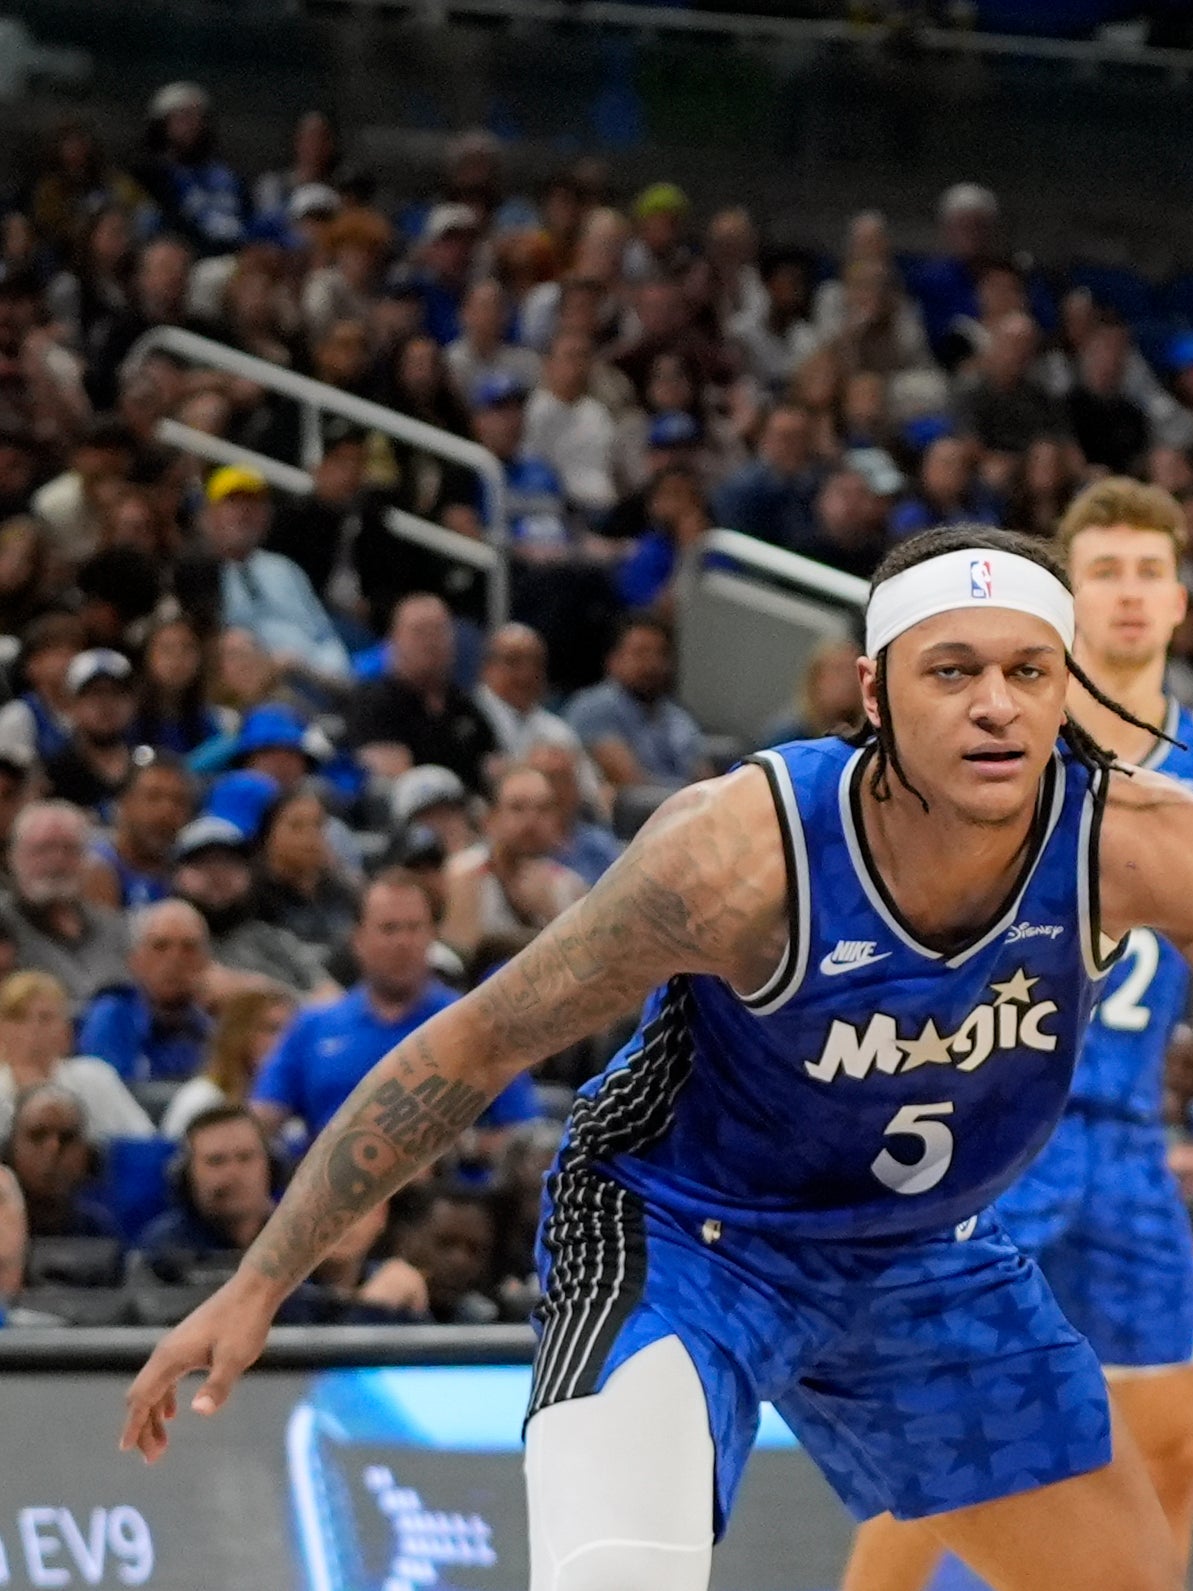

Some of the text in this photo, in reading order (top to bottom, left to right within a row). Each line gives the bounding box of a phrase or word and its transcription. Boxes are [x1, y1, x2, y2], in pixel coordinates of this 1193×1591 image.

[832, 939, 878, 962] NIKE
[1090, 927, 1160, 1031] 2
[870, 1101, 954, 1195] 5
[19, 1504, 154, 1585] EV9
